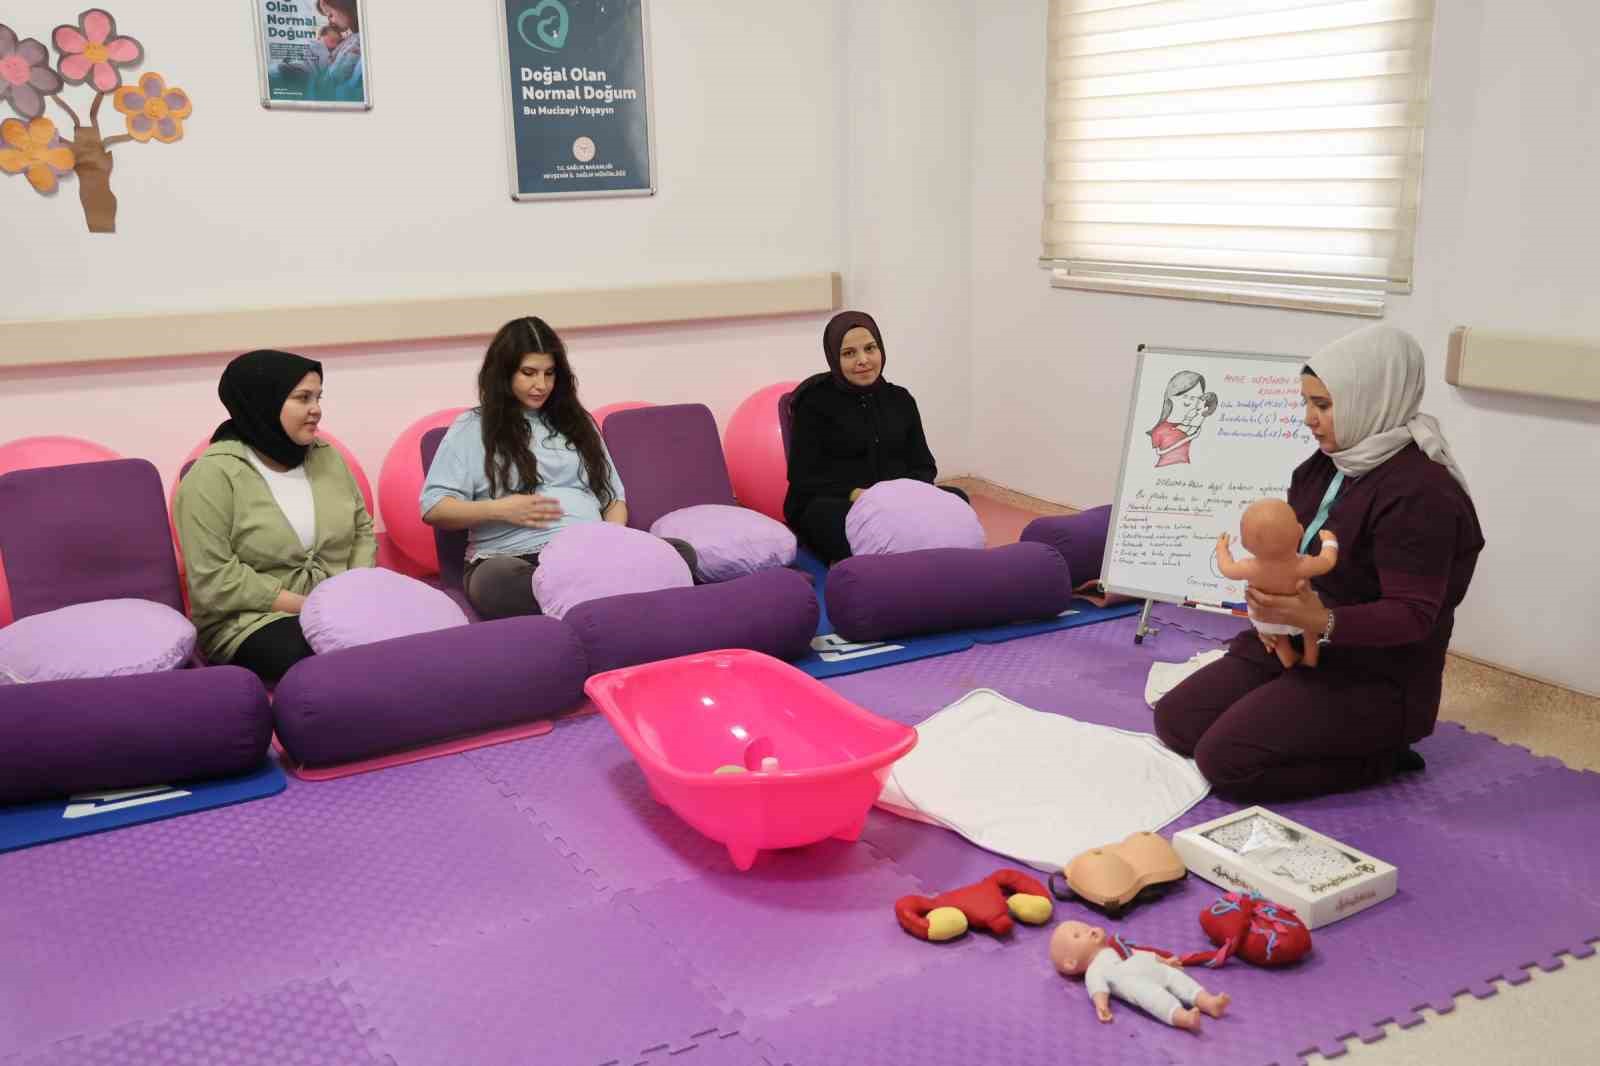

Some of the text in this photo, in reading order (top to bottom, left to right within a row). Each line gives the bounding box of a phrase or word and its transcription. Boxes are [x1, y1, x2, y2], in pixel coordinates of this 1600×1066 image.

[266, 1, 298, 12] Olan
[267, 14, 317, 26] Normal
[268, 27, 316, 40] Doğum
[520, 66, 607, 85] Doğal Olan
[522, 85, 637, 103] Normal Doğum
[523, 105, 614, 117] Bu Mucizeyi Yaşayın
